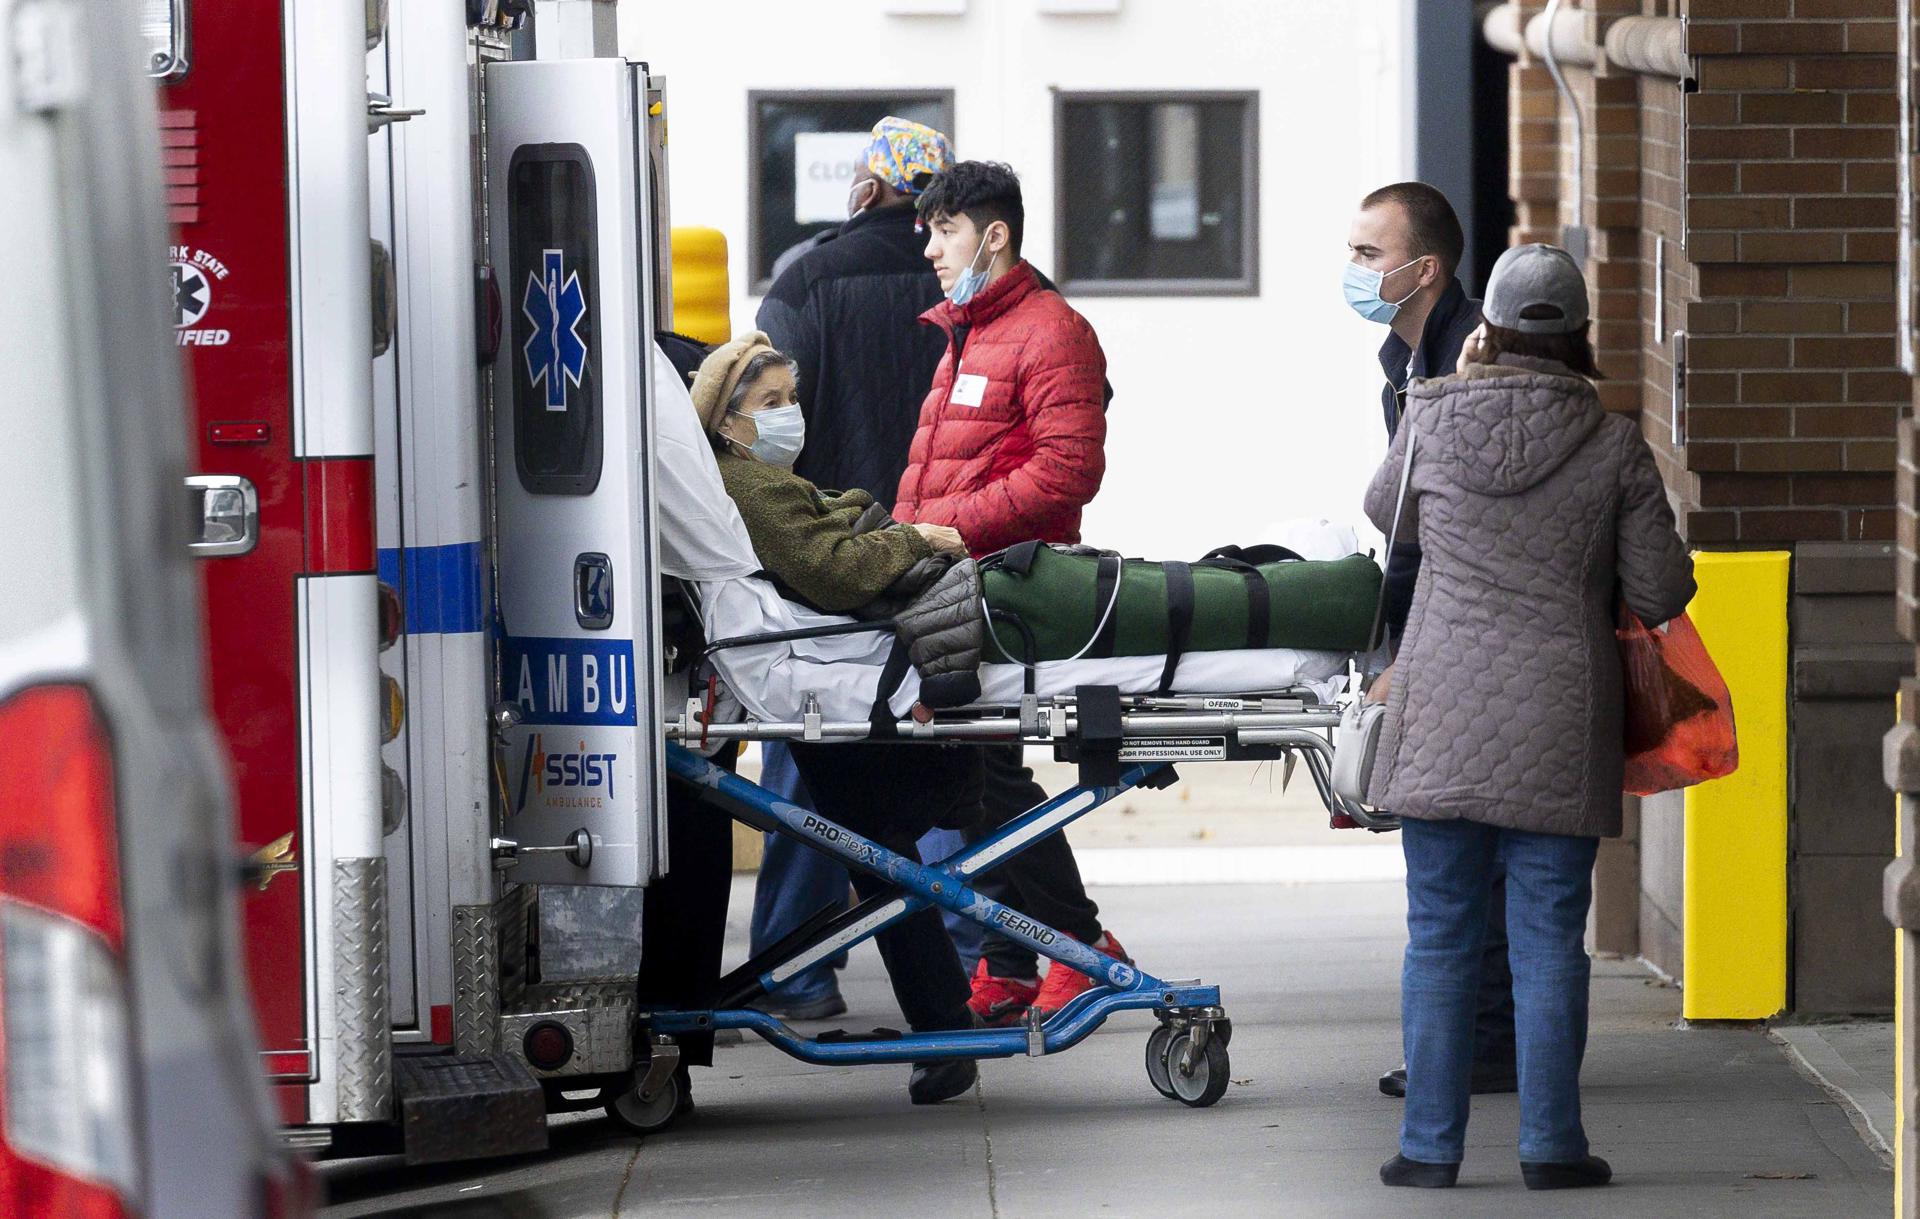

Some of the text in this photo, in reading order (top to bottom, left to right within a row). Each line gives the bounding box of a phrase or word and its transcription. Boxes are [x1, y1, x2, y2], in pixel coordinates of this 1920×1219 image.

[808, 161, 854, 181] CLO
[169, 246, 189, 258] RK
[193, 249, 230, 280] STATE
[176, 329, 231, 346] IFIED
[518, 654, 628, 714] AMBU
[1215, 701, 1240, 709] FERNO
[545, 796, 603, 809] AMBULANCE
[995, 909, 1057, 946] FERNO
